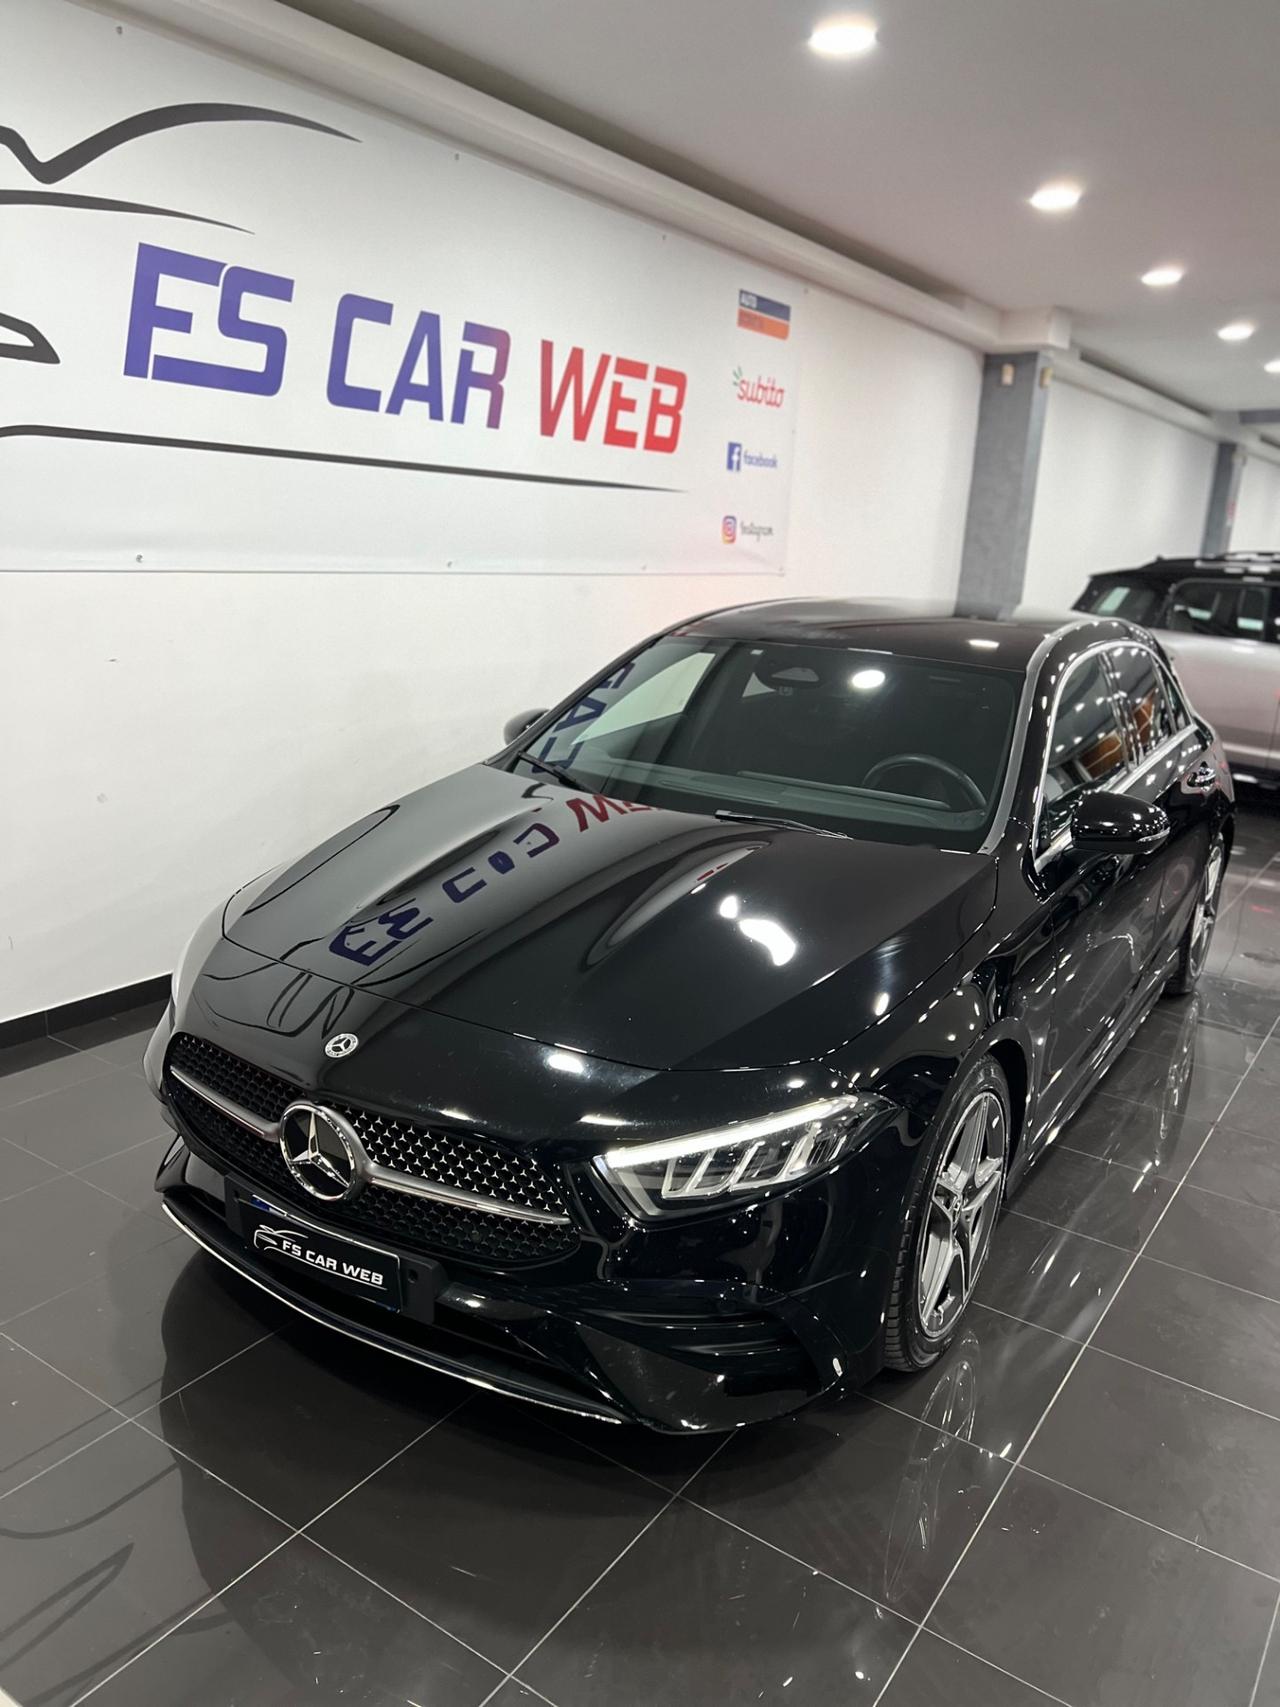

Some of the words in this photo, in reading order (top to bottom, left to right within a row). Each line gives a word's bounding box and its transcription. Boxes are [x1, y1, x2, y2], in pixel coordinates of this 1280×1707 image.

[124, 242, 294, 397] ES
[327, 294, 511, 429] CAR
[540, 339, 688, 453] WEB
[737, 375, 785, 408] subito
[305, 1249, 337, 1271] CAR
[342, 1262, 384, 1285] WEB
